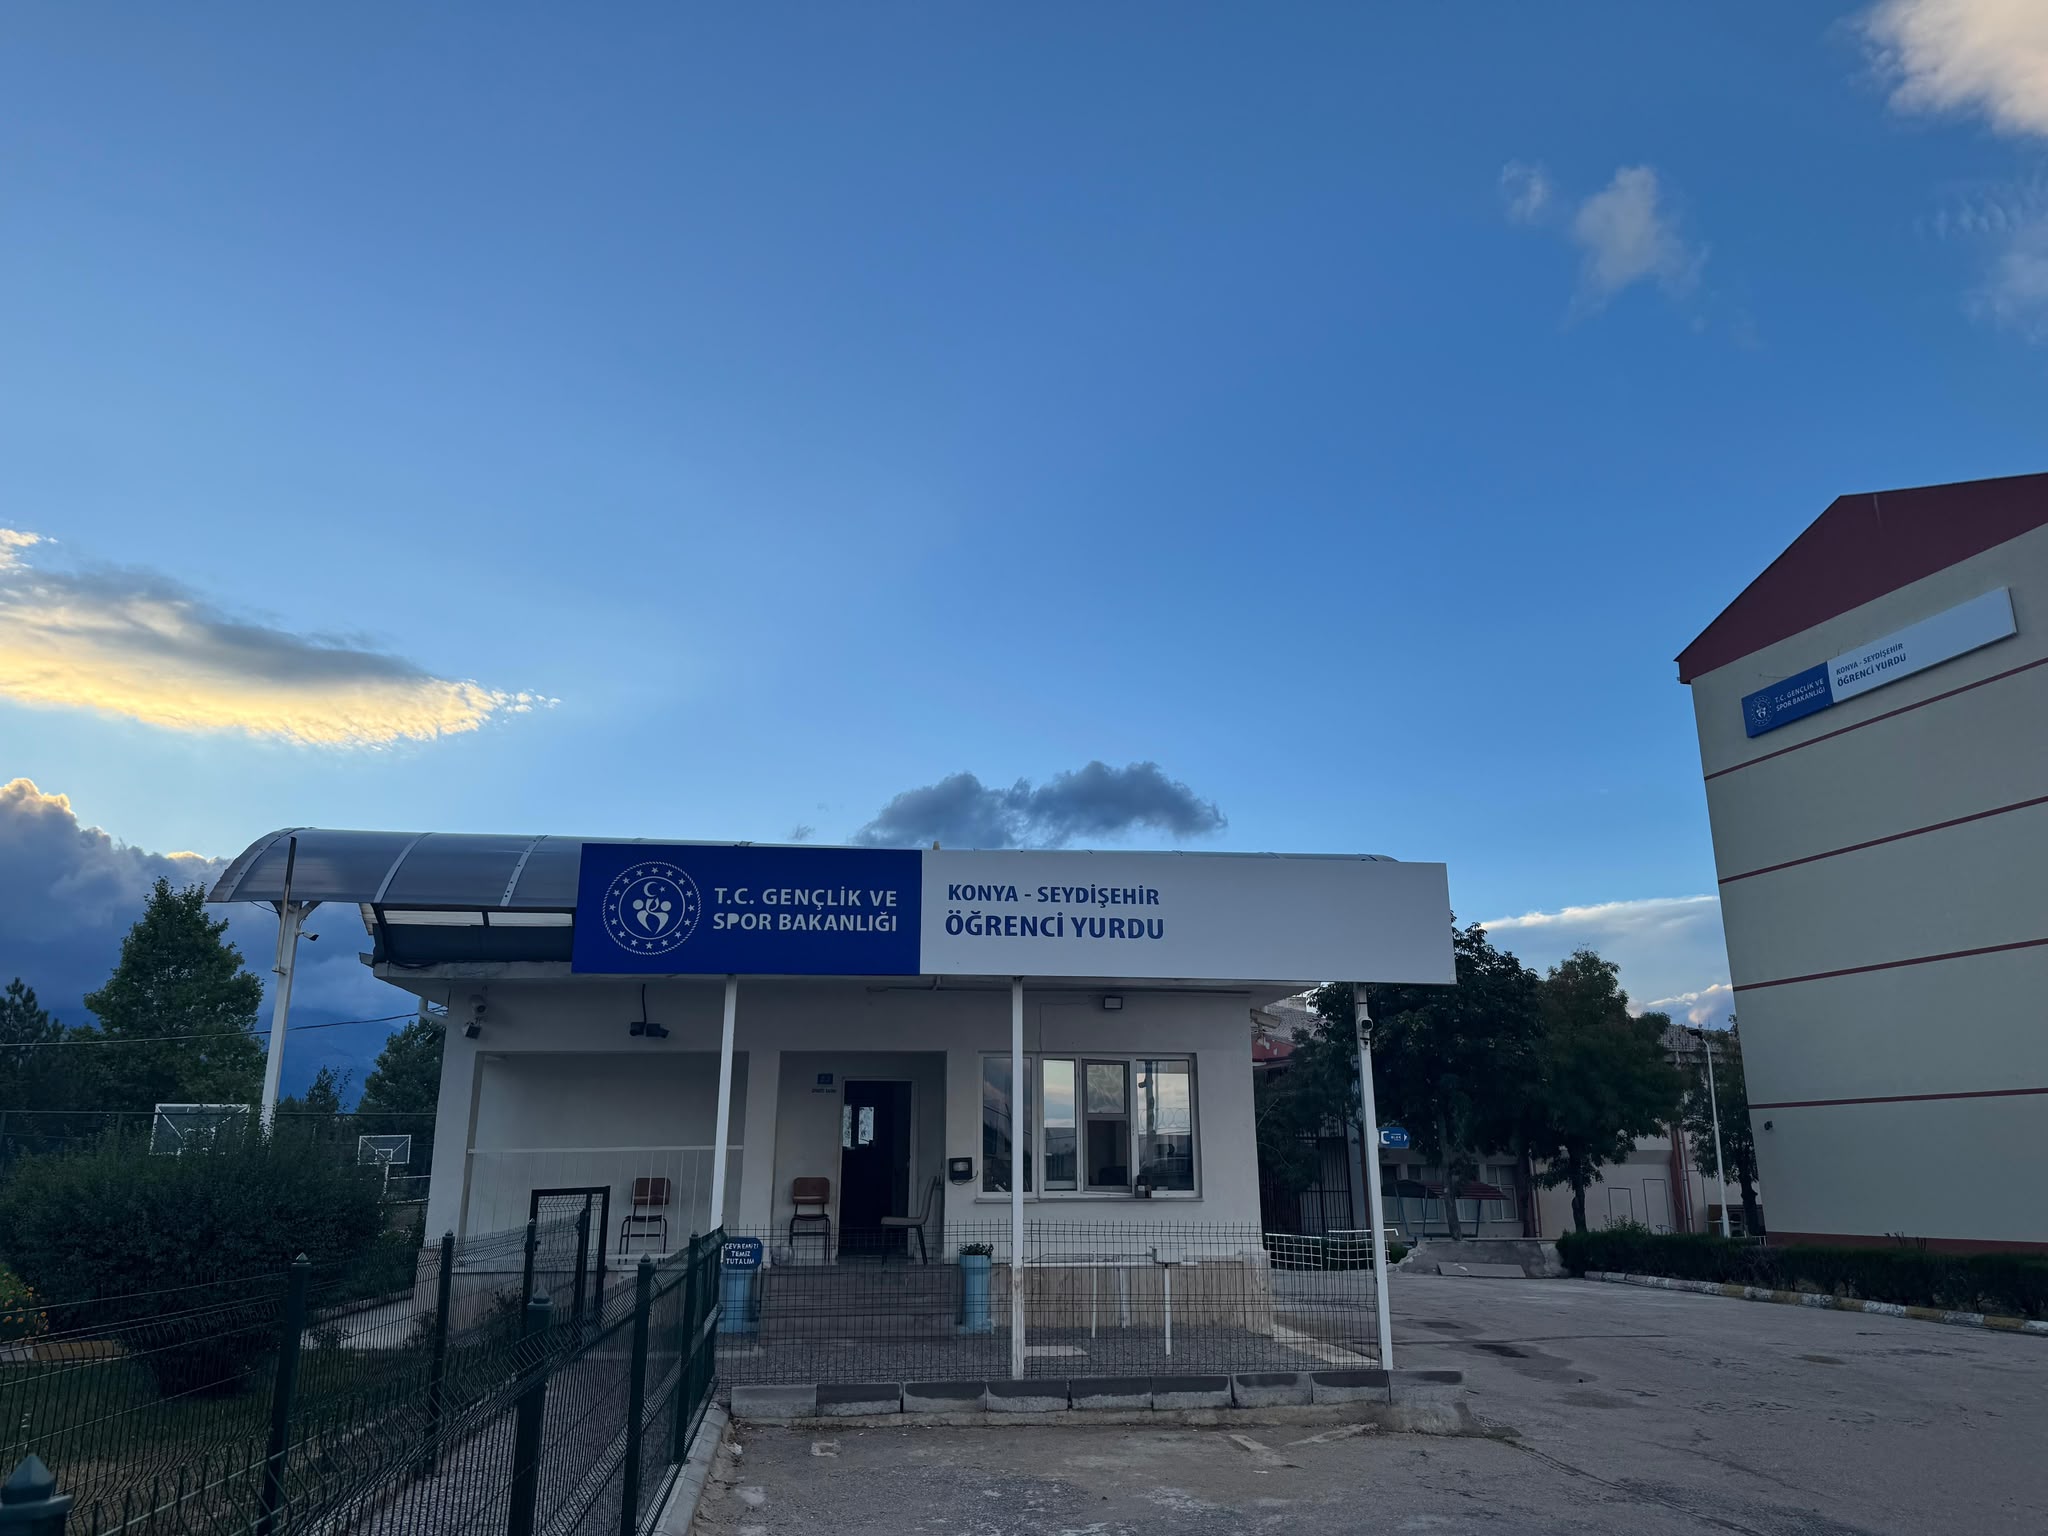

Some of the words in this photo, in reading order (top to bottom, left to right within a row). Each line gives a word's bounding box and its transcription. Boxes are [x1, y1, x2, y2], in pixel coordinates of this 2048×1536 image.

[1836, 661, 1858, 675] KONYA
[1863, 642, 1904, 664] SEYDİŞEHİR
[1837, 664, 1874, 687] ÖĞRENCİ
[1876, 653, 1906, 671] YURDU
[1775, 694, 1786, 703] T.C.
[1787, 683, 1814, 698] GENÇLİK
[1815, 678, 1824, 686] VE
[1776, 700, 1792, 712] SPOR
[1793, 686, 1825, 705] BAKANLIĞI
[715, 887, 755, 905] T.C.
[763, 886, 862, 910] GENÇLİK
[870, 890, 897, 907] VE
[948, 884, 1018, 902] KONYA
[1037, 883, 1160, 909] SEYDİŞEHİR
[712, 912, 772, 930] SPOR
[779, 911, 897, 932] BAKANLIĞI
[945, 909, 1064, 938] ÖĞRENCİ
[1070, 916, 1164, 940] YURDU
